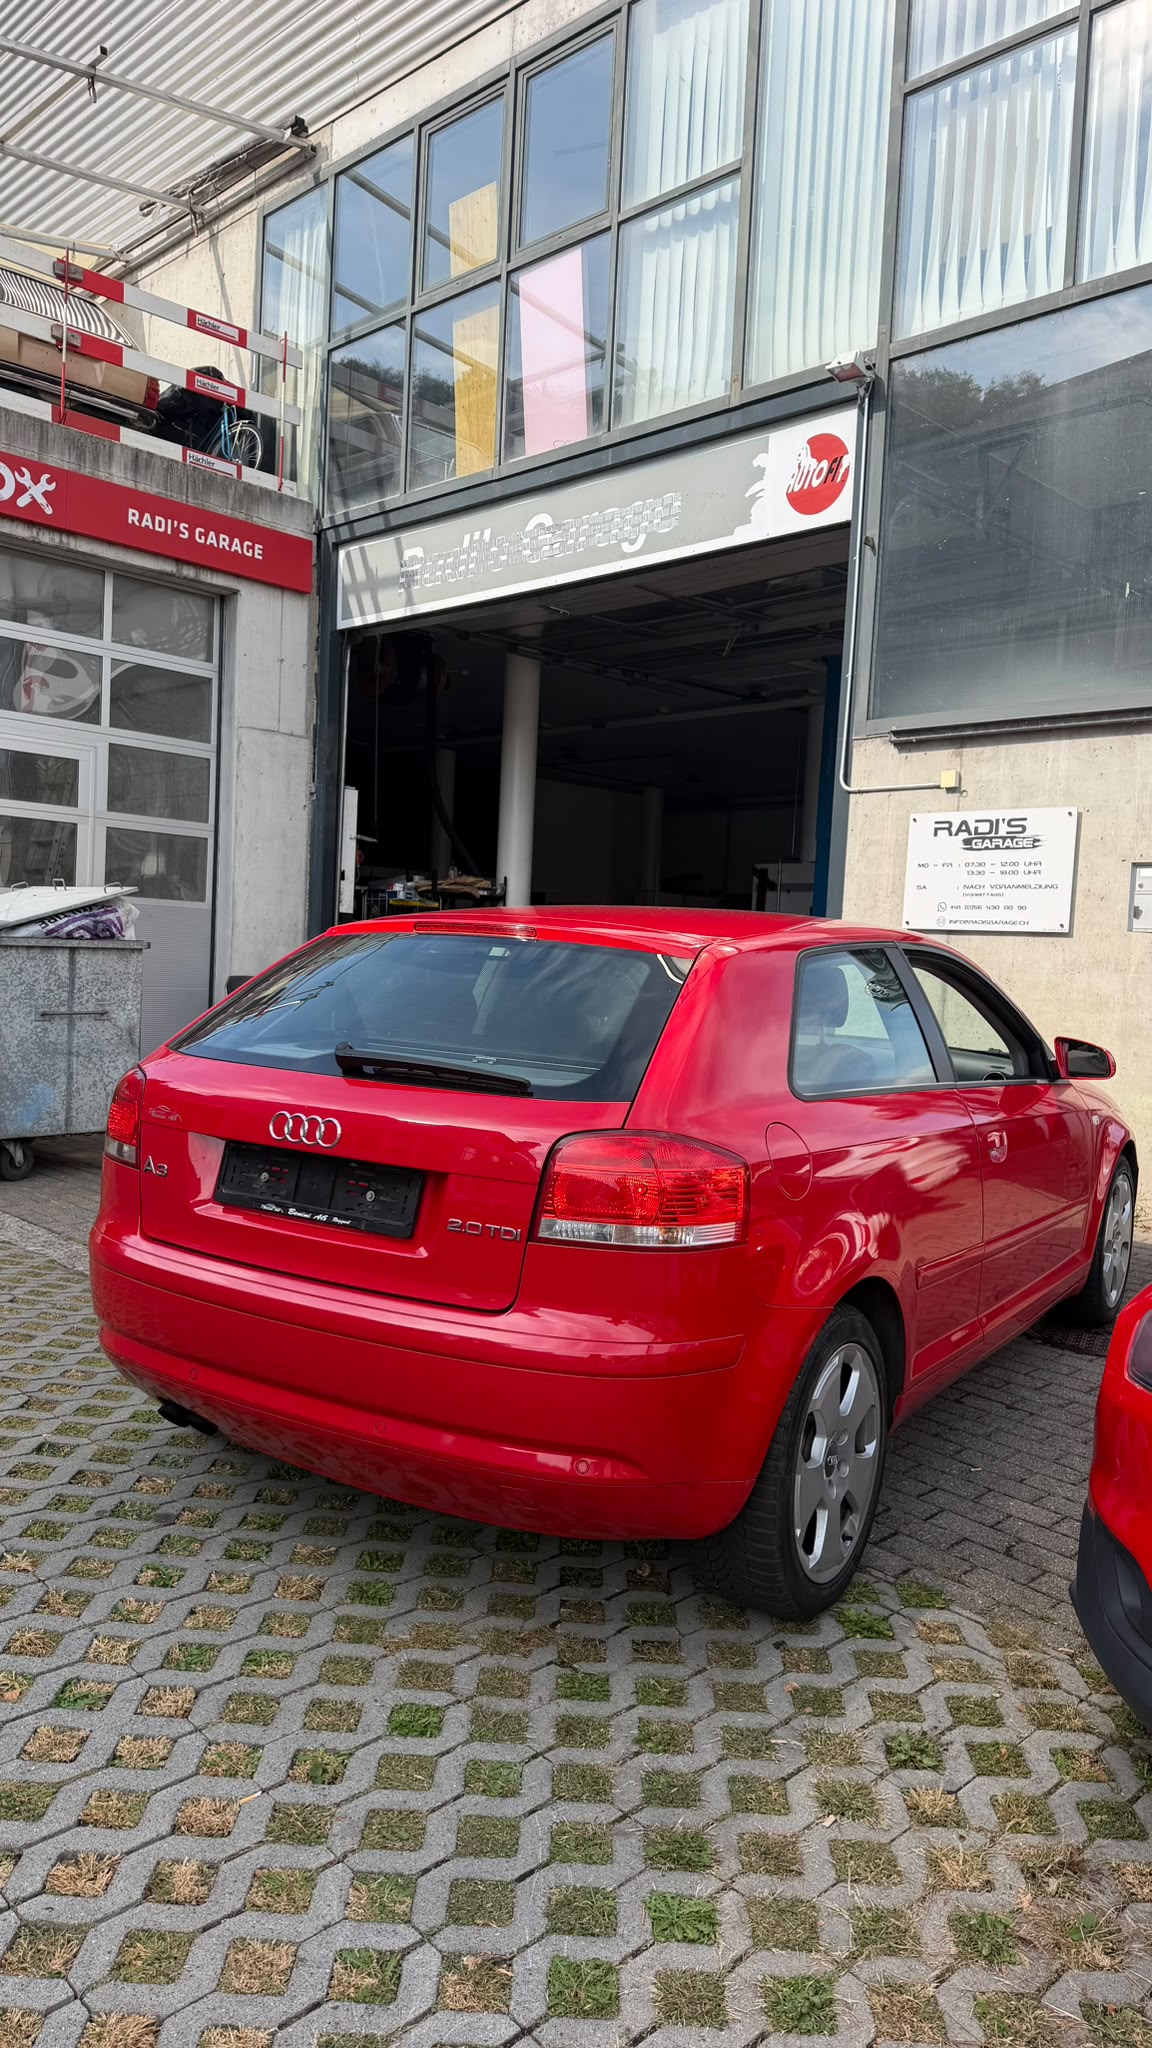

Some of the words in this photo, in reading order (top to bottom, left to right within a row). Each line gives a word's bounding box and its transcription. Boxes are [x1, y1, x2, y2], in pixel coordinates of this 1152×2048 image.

[188, 452, 216, 468] Hächler
[128, 507, 190, 540] RADI'S
[194, 527, 264, 560] GARAGE
[933, 817, 1028, 837] RADI'S
[971, 838, 1034, 849] GARAGE
[143, 1155, 168, 1177] A3
[313, 1213, 329, 1222] AG
[447, 1218, 482, 1235] 2.0
[485, 1223, 522, 1241] TDI
